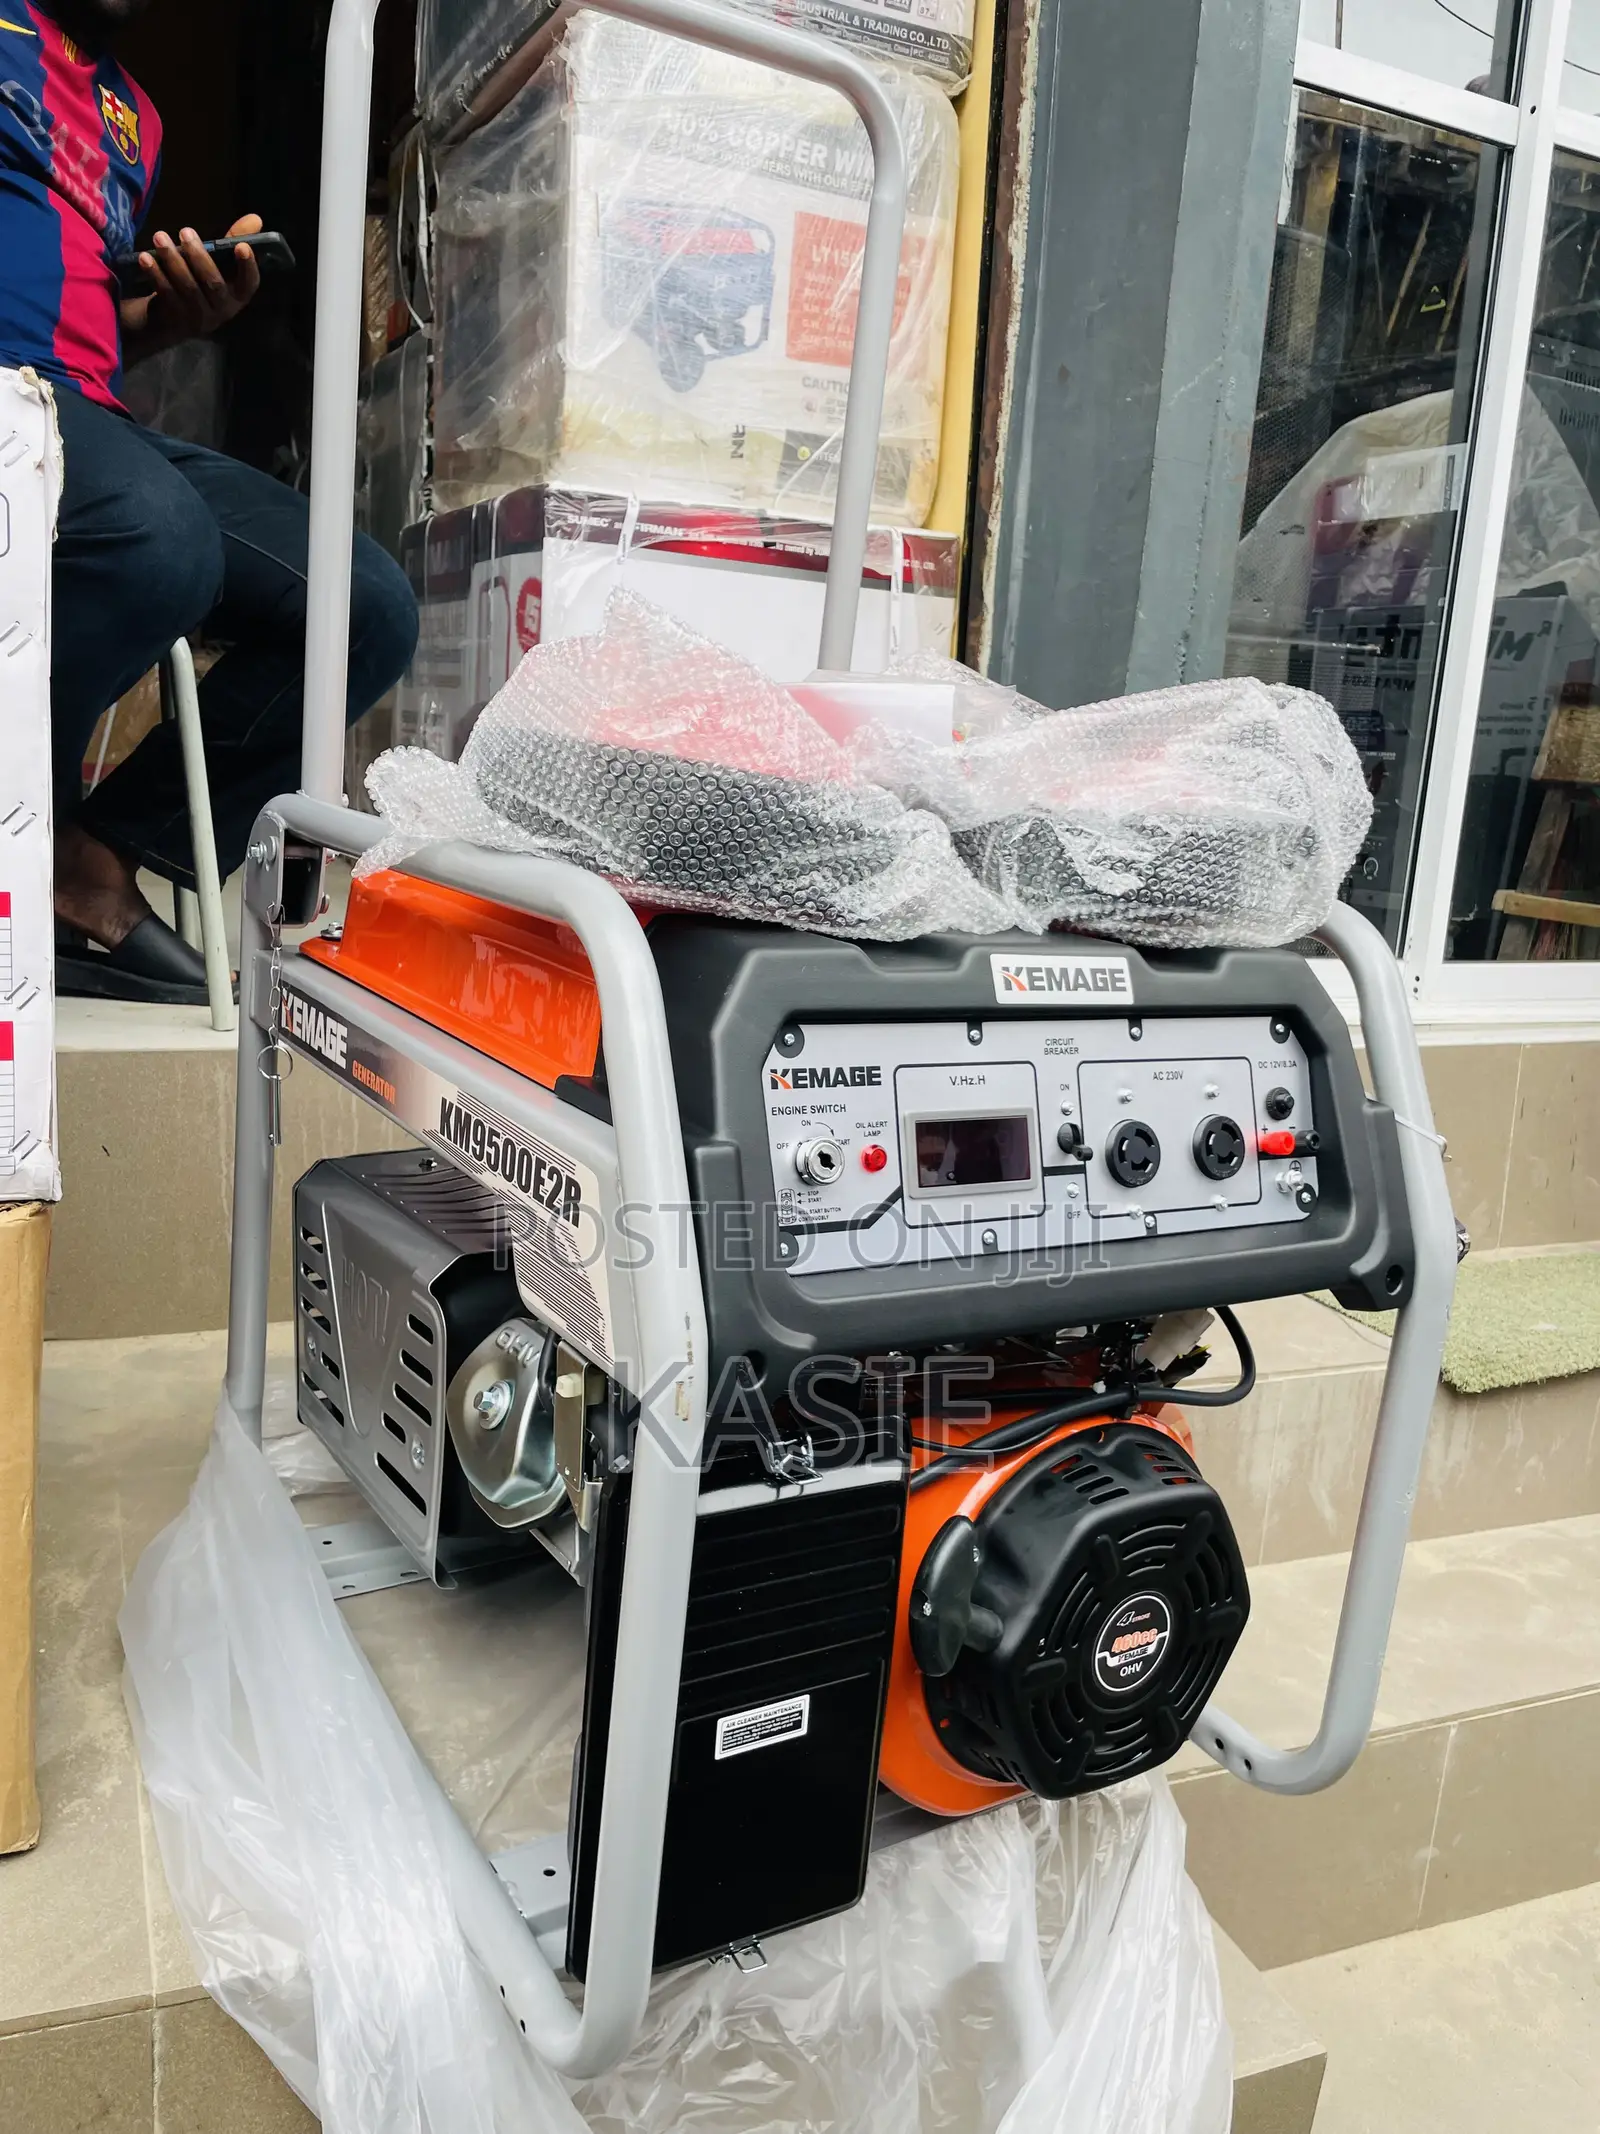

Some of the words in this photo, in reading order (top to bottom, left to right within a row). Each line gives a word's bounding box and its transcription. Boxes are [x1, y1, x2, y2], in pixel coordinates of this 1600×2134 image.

[852, 15, 860, 25] &
[862, 17, 908, 39] TRADING
[795, 166, 822, 184] WITH
[823, 174, 849, 190] OUR
[997, 966, 1128, 992] KEMAGE
[280, 985, 348, 1070] KEMAGE
[1045, 1037, 1075, 1047] CIRCUIT
[1044, 1047, 1080, 1055] BREAKER
[1257, 1061, 1268, 1069] DC
[352, 1059, 397, 1105] GENERATOR
[769, 1065, 883, 1091] KEMAGE
[949, 1074, 986, 1087] V.Hz.H
[1152, 1072, 1164, 1081] AC
[1165, 1071, 1184, 1081] 230V
[1059, 1083, 1070, 1091] ON
[771, 1105, 808, 1117] ENGINE
[810, 1104, 847, 1115] SWITCH
[801, 1119, 812, 1127] ON
[776, 1142, 790, 1150] OFF
[836, 1138, 851, 1147] TART
[439, 1096, 582, 1228] KM9500E2R
[1067, 1211, 1081, 1219] OFF
[340, 1255, 390, 1347] HOT!
[1119, 1660, 1143, 1677] OHV
[726, 1721, 737, 1729] AIR
[736, 1713, 762, 1726] CLEANER
[763, 1703, 802, 1718] MAINTENANCE
